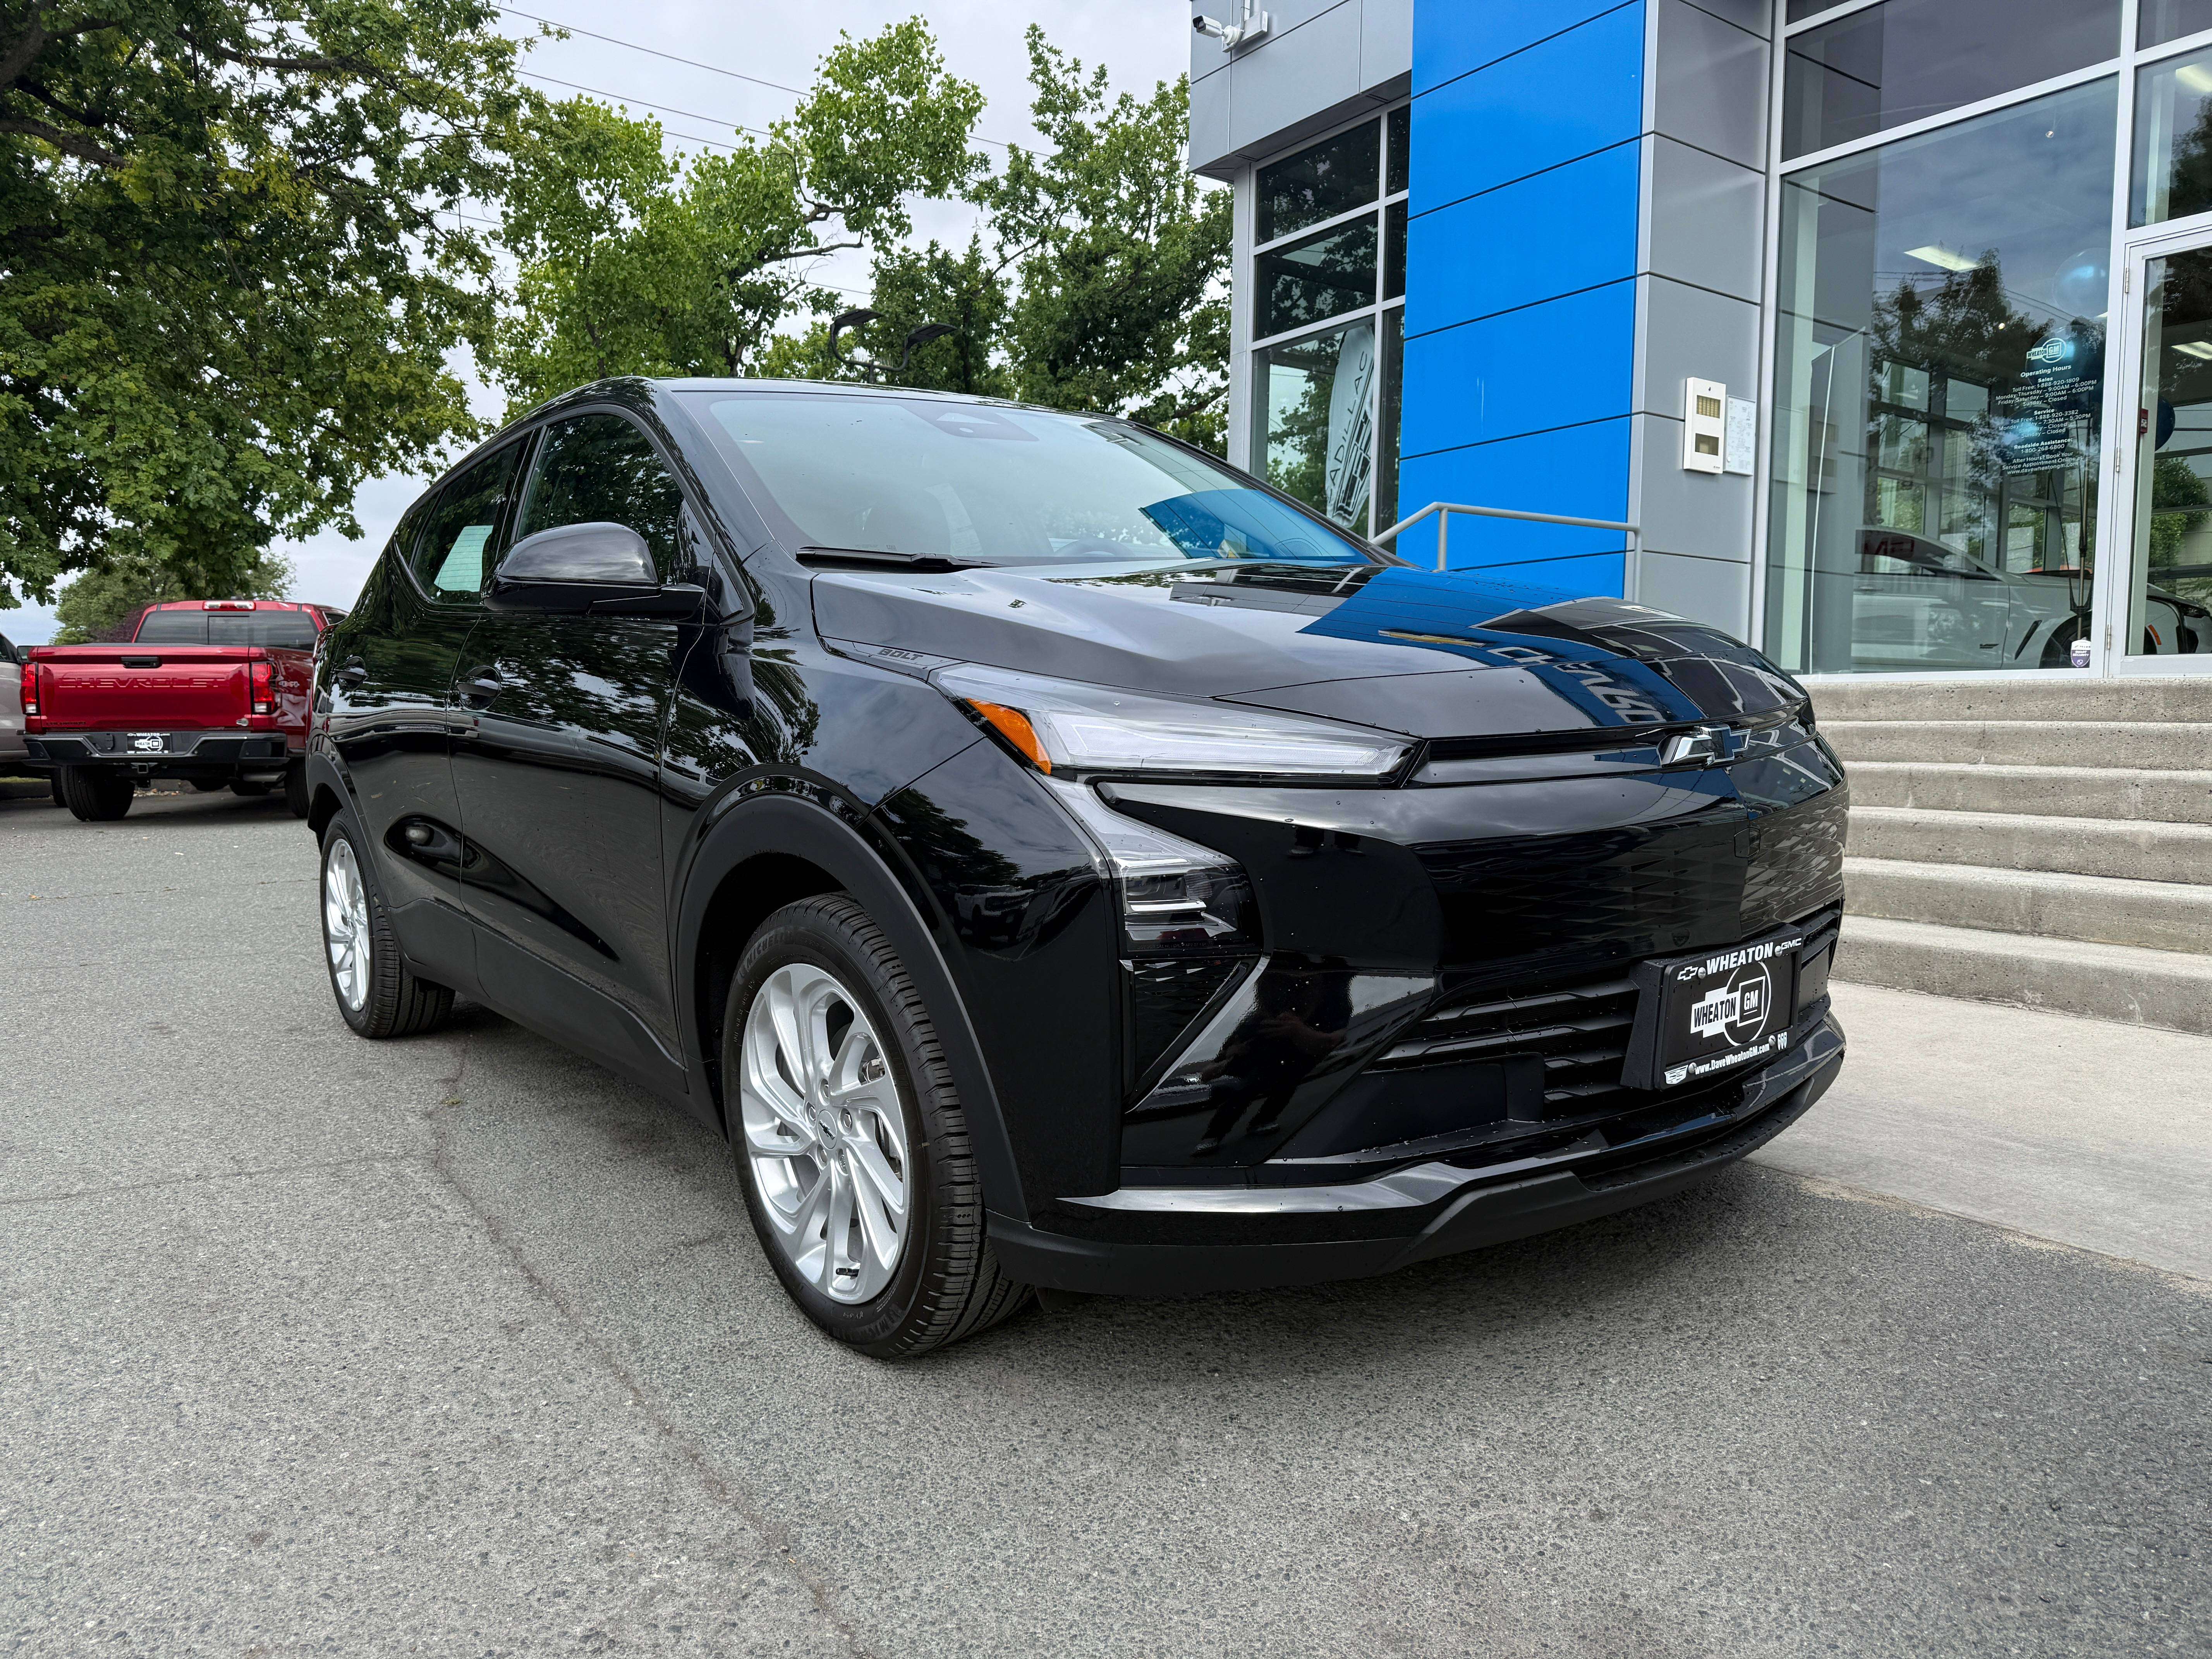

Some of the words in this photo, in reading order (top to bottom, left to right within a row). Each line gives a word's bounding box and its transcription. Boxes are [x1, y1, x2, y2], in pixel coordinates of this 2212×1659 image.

[2049, 345, 2060, 354] GM
[2020, 369, 2051, 378] Operating
[2037, 377, 2080, 388] 1-888-920-1809
[2048, 384, 2069, 392] 9:00AM
[2035, 409, 2078, 420] 1-888-920-3382
[2070, 413, 2091, 421] 5:30PM
[2040, 438, 2073, 446] Assistance:
[2021, 443, 2065, 454] 1-800-268-6800
[2022, 459, 2057, 469] Appointment
[878, 648, 923, 661] BOLT
[58, 677, 225, 688] CHEVROLET
[1706, 942, 1773, 975] WHEATON
[1781, 938, 1802, 950] GMC
[1694, 997, 1736, 1028] WHEATON
[1743, 989, 1759, 1011] GM
[1695, 1043, 1770, 1075] www.DaveWheatonGM.com
